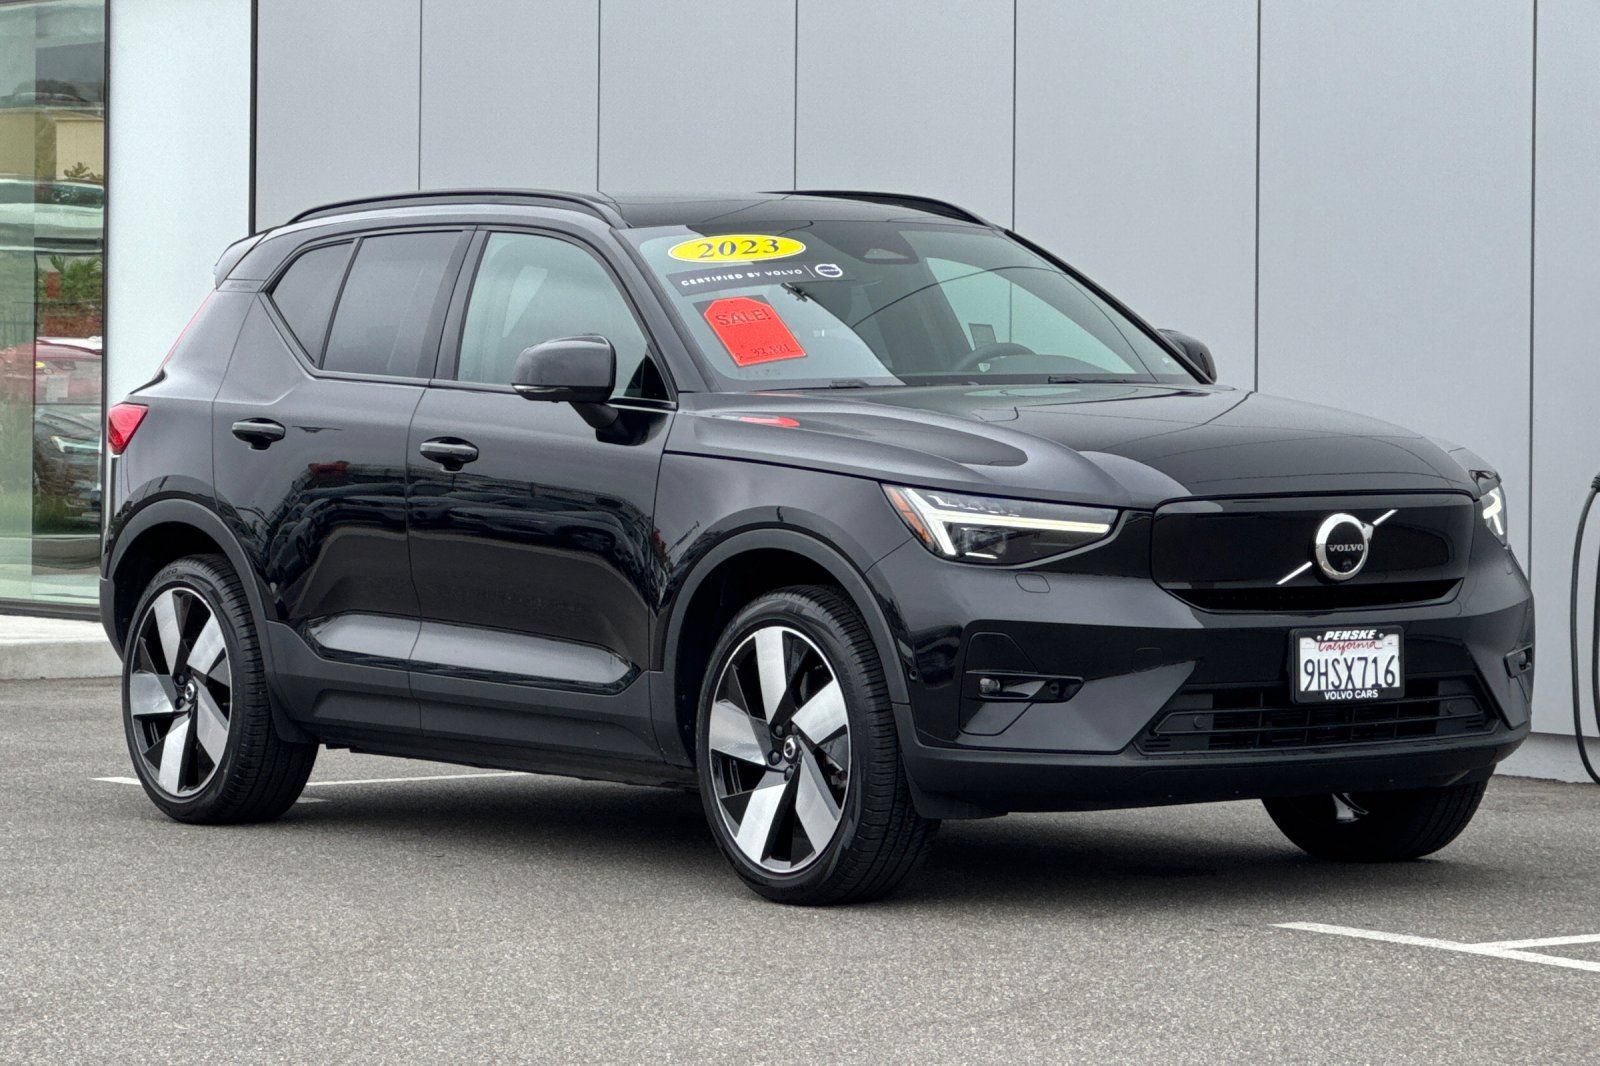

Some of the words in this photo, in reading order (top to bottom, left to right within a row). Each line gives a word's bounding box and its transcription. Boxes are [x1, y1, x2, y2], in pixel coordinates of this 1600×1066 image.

[698, 239, 780, 258] 2023
[682, 274, 744, 287] CERTIFIED
[747, 271, 761, 279] BY
[764, 269, 803, 277] VOLVO
[715, 309, 772, 326] SALE!
[1327, 544, 1365, 553] VOLVO
[1323, 629, 1377, 641] PENSKE
[1317, 640, 1383, 656] California
[1304, 655, 1396, 691] 9HSX716
[1324, 690, 1354, 701] VOLVO
[1355, 688, 1379, 699] CARS
